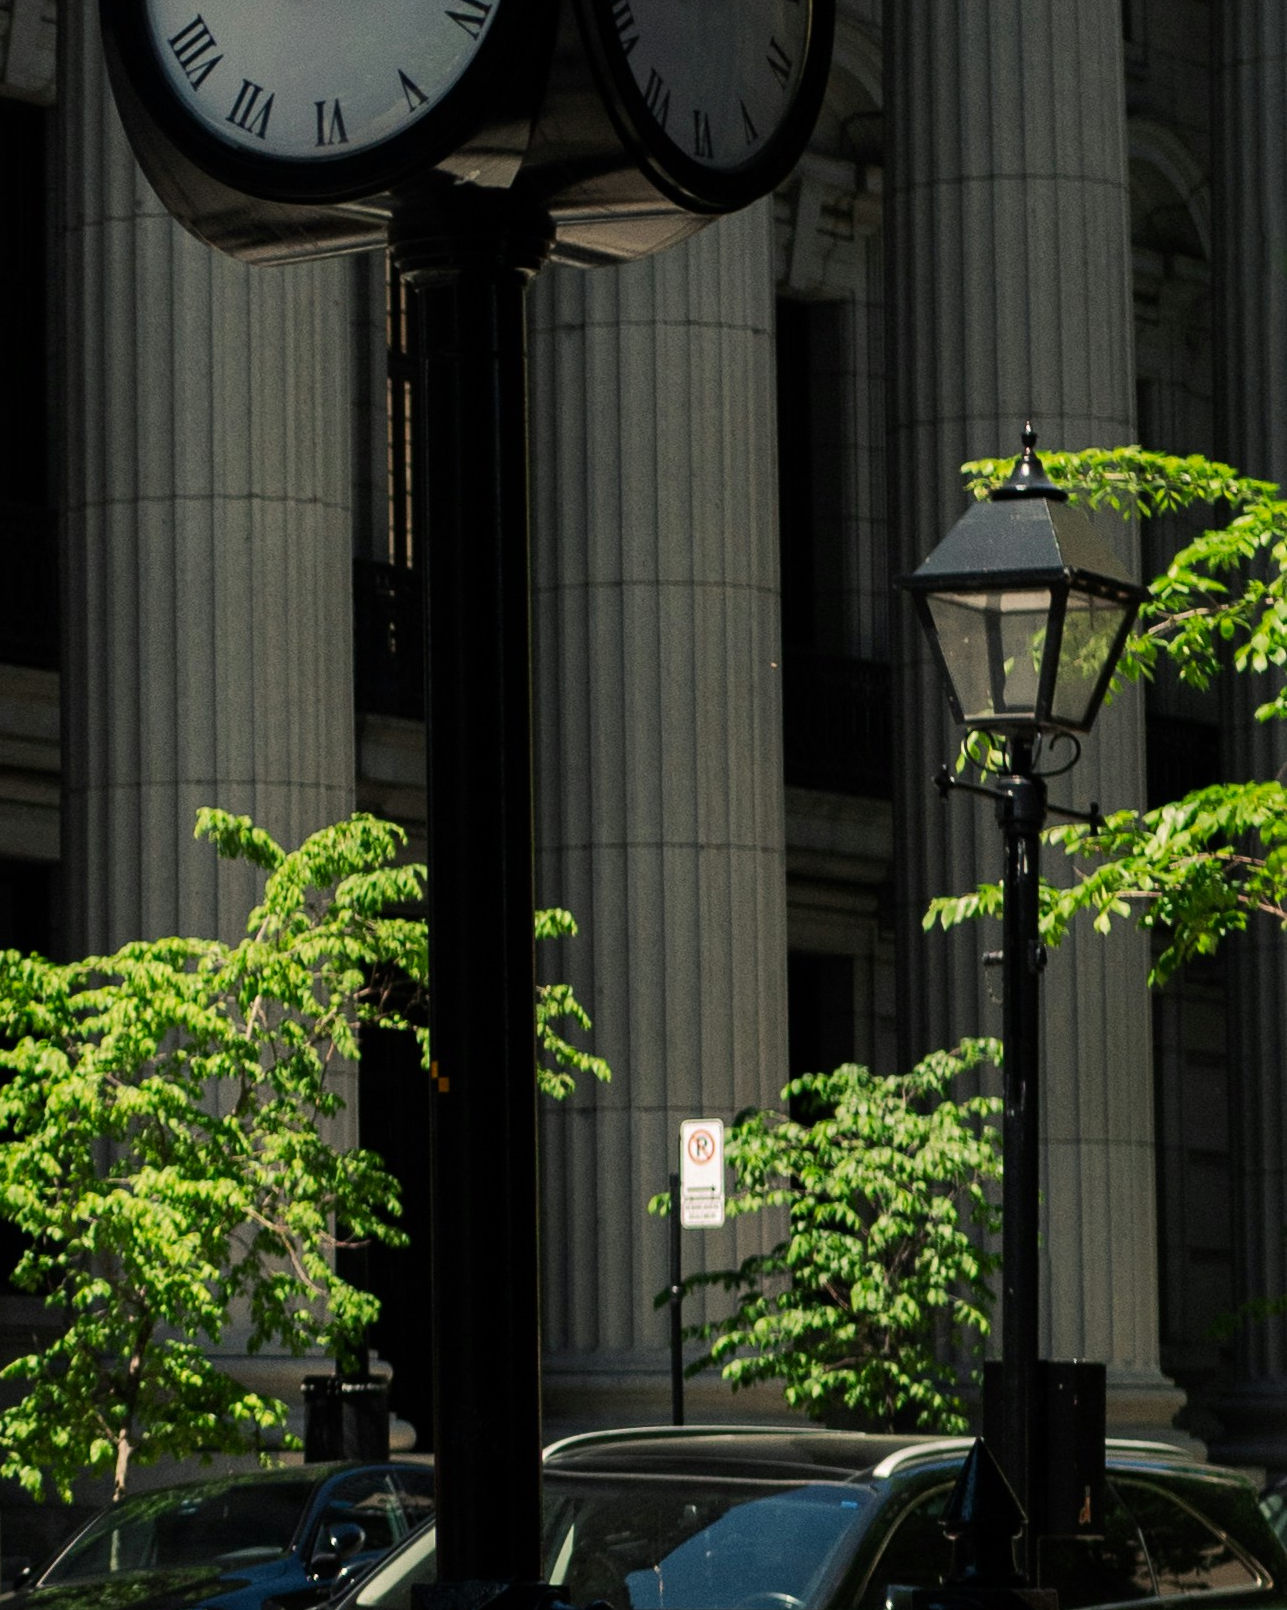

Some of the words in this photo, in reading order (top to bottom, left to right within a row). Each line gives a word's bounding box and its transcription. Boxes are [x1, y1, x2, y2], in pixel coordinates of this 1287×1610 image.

[167, 14, 223, 91] VIII
[766, 36, 793, 90] IV
[225, 78, 275, 140] VII
[397, 69, 429, 113] V
[314, 98, 348, 147] VI
[693, 109, 714, 159] VI
